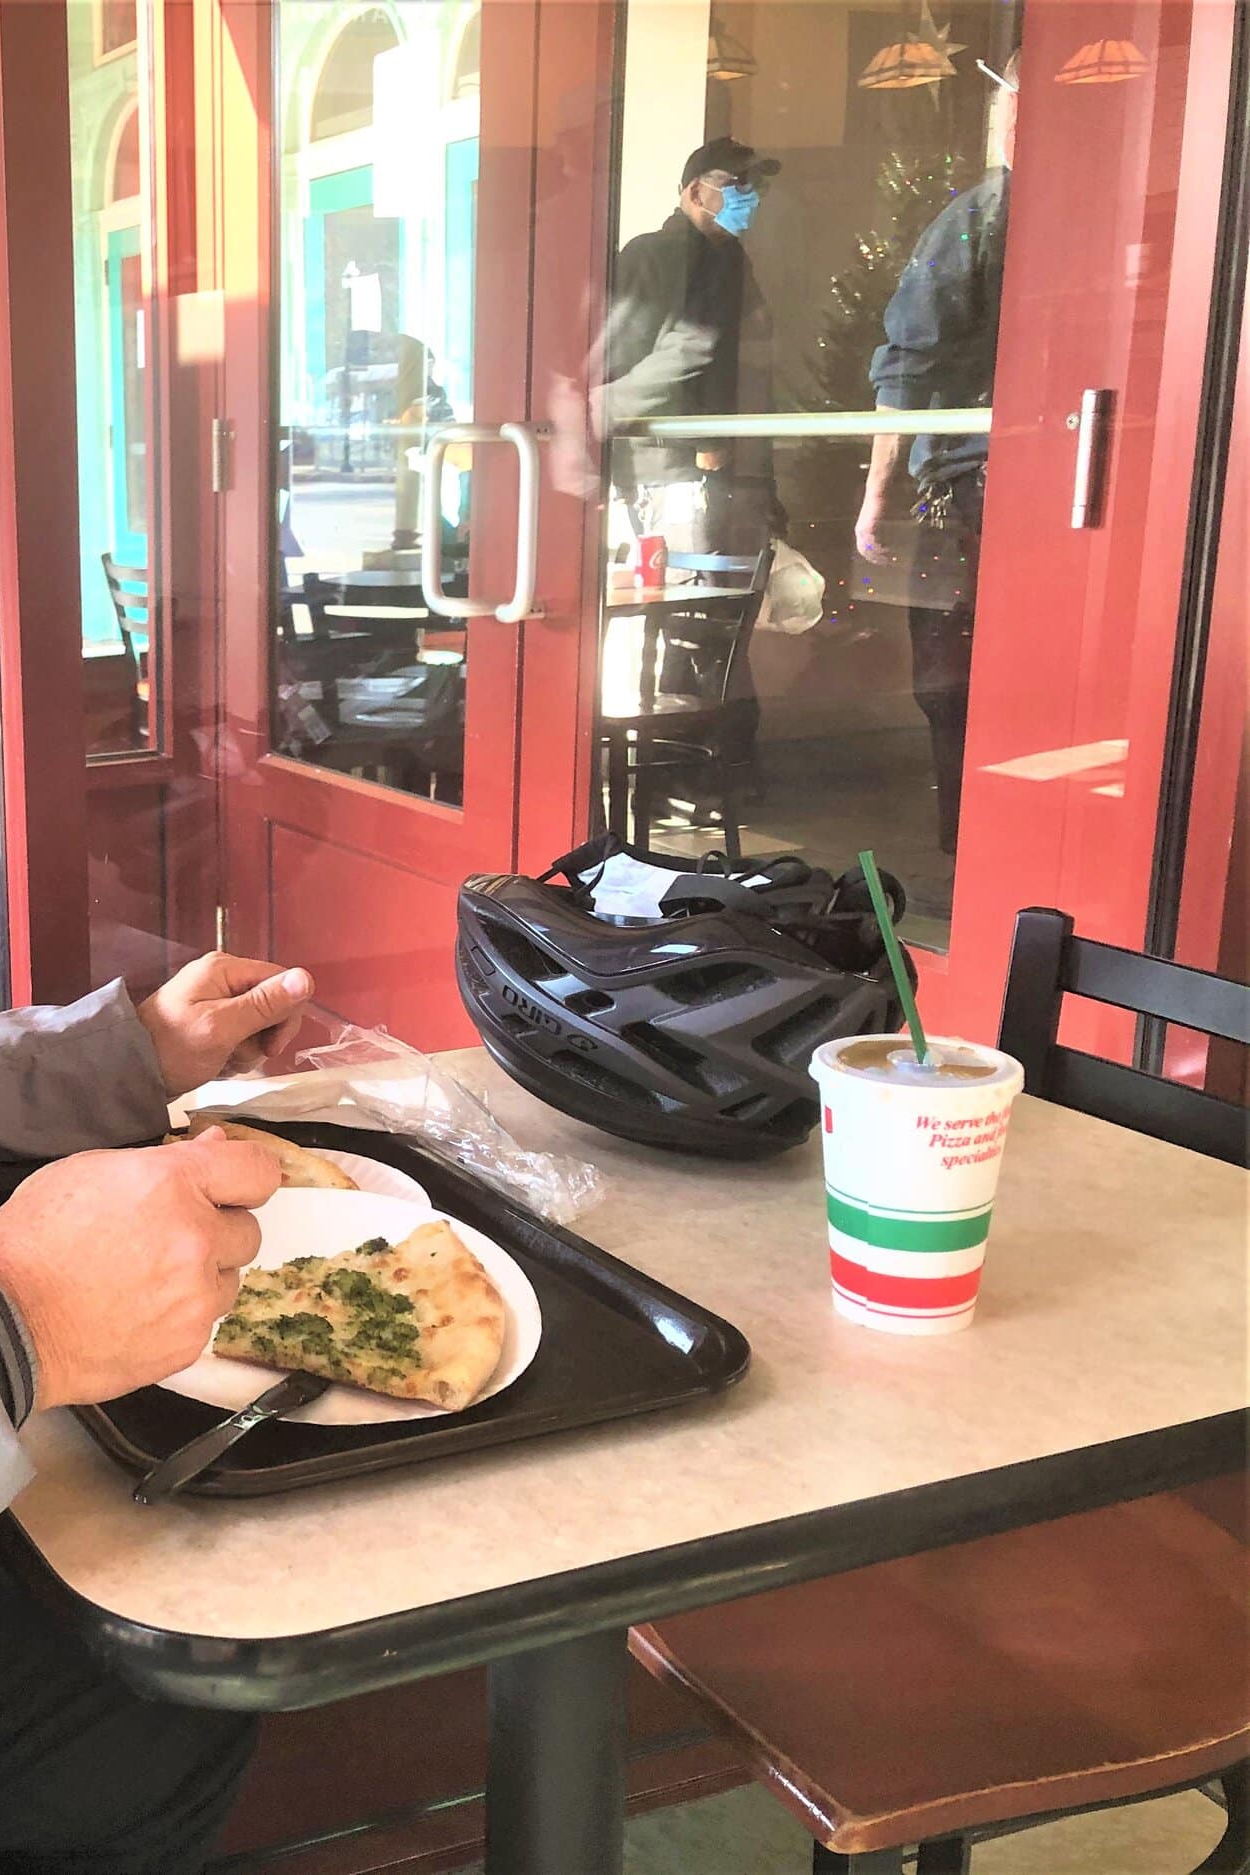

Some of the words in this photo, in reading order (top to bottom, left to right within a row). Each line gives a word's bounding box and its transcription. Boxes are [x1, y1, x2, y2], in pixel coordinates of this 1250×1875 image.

[502, 984, 563, 1036] GIRO
[916, 1115, 942, 1130] We
[943, 1117, 984, 1130] serve
[928, 1133, 972, 1148] Pizza
[973, 1128, 997, 1145] and
